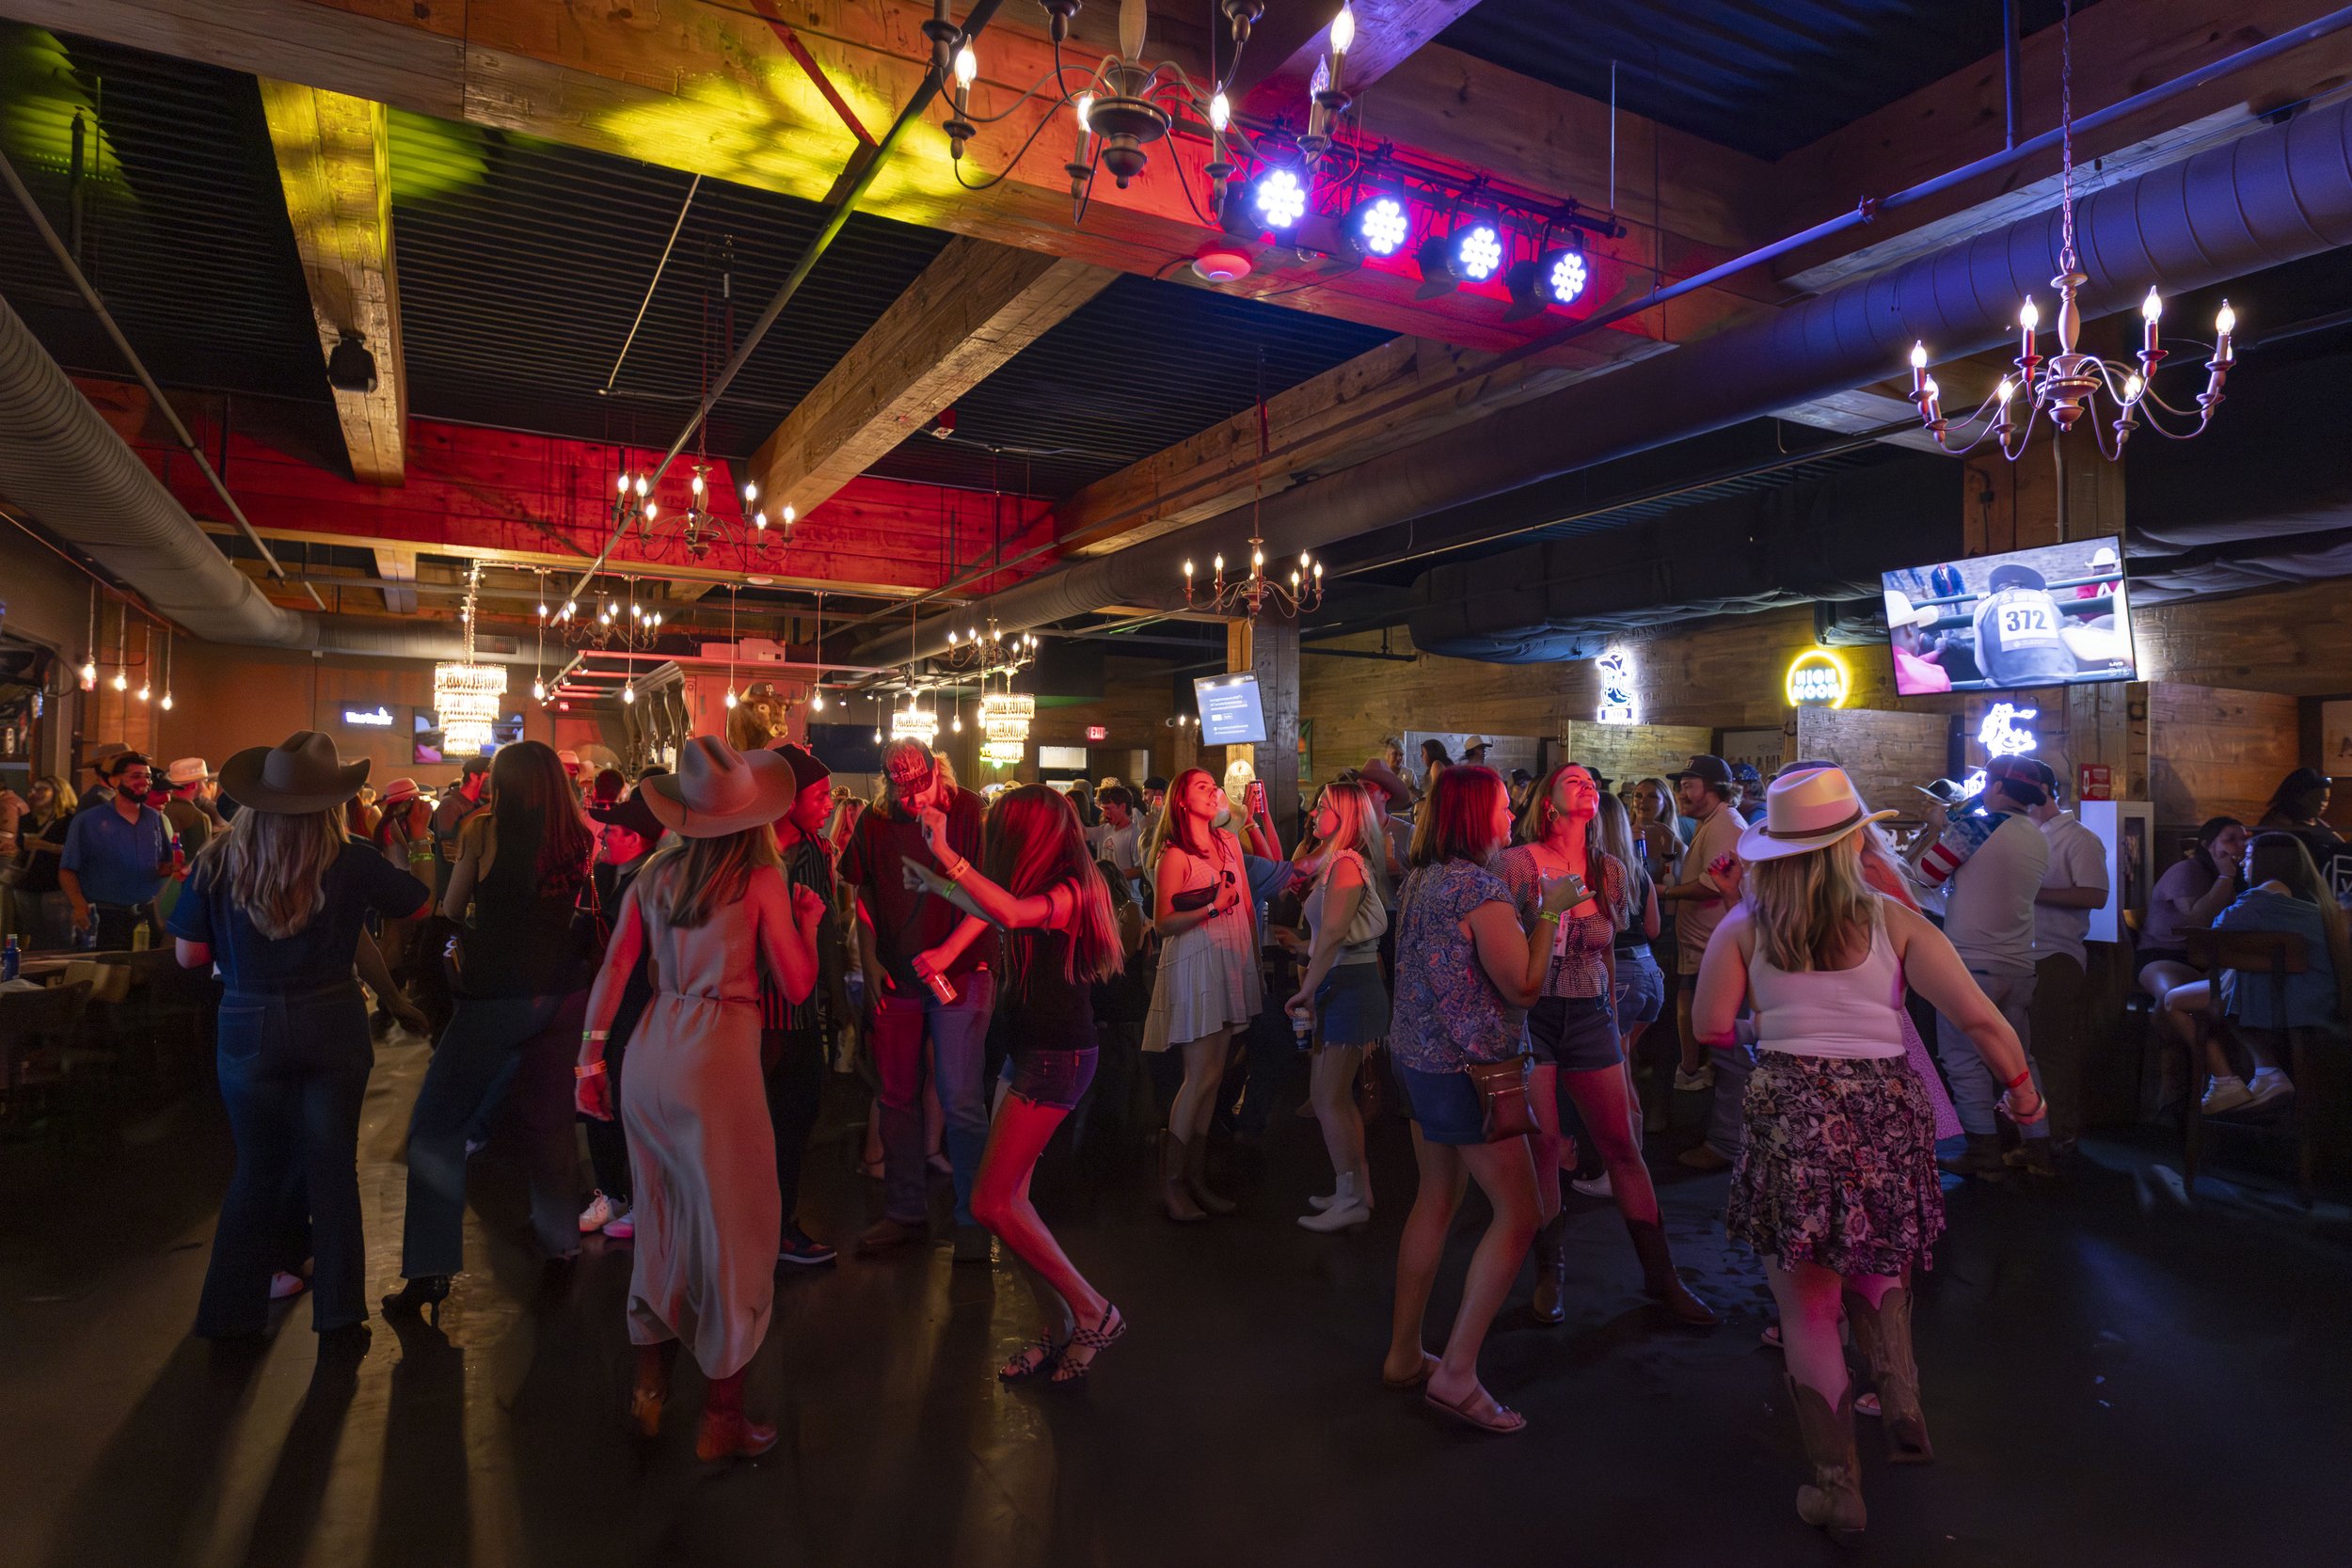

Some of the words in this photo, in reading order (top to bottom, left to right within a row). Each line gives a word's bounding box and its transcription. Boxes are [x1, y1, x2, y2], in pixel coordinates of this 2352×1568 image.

[2006, 610, 2048, 632] 372
[1795, 668, 1836, 686] HIGH
[1793, 682, 1840, 700] NOON
[1090, 727, 1104, 739] EXIT
